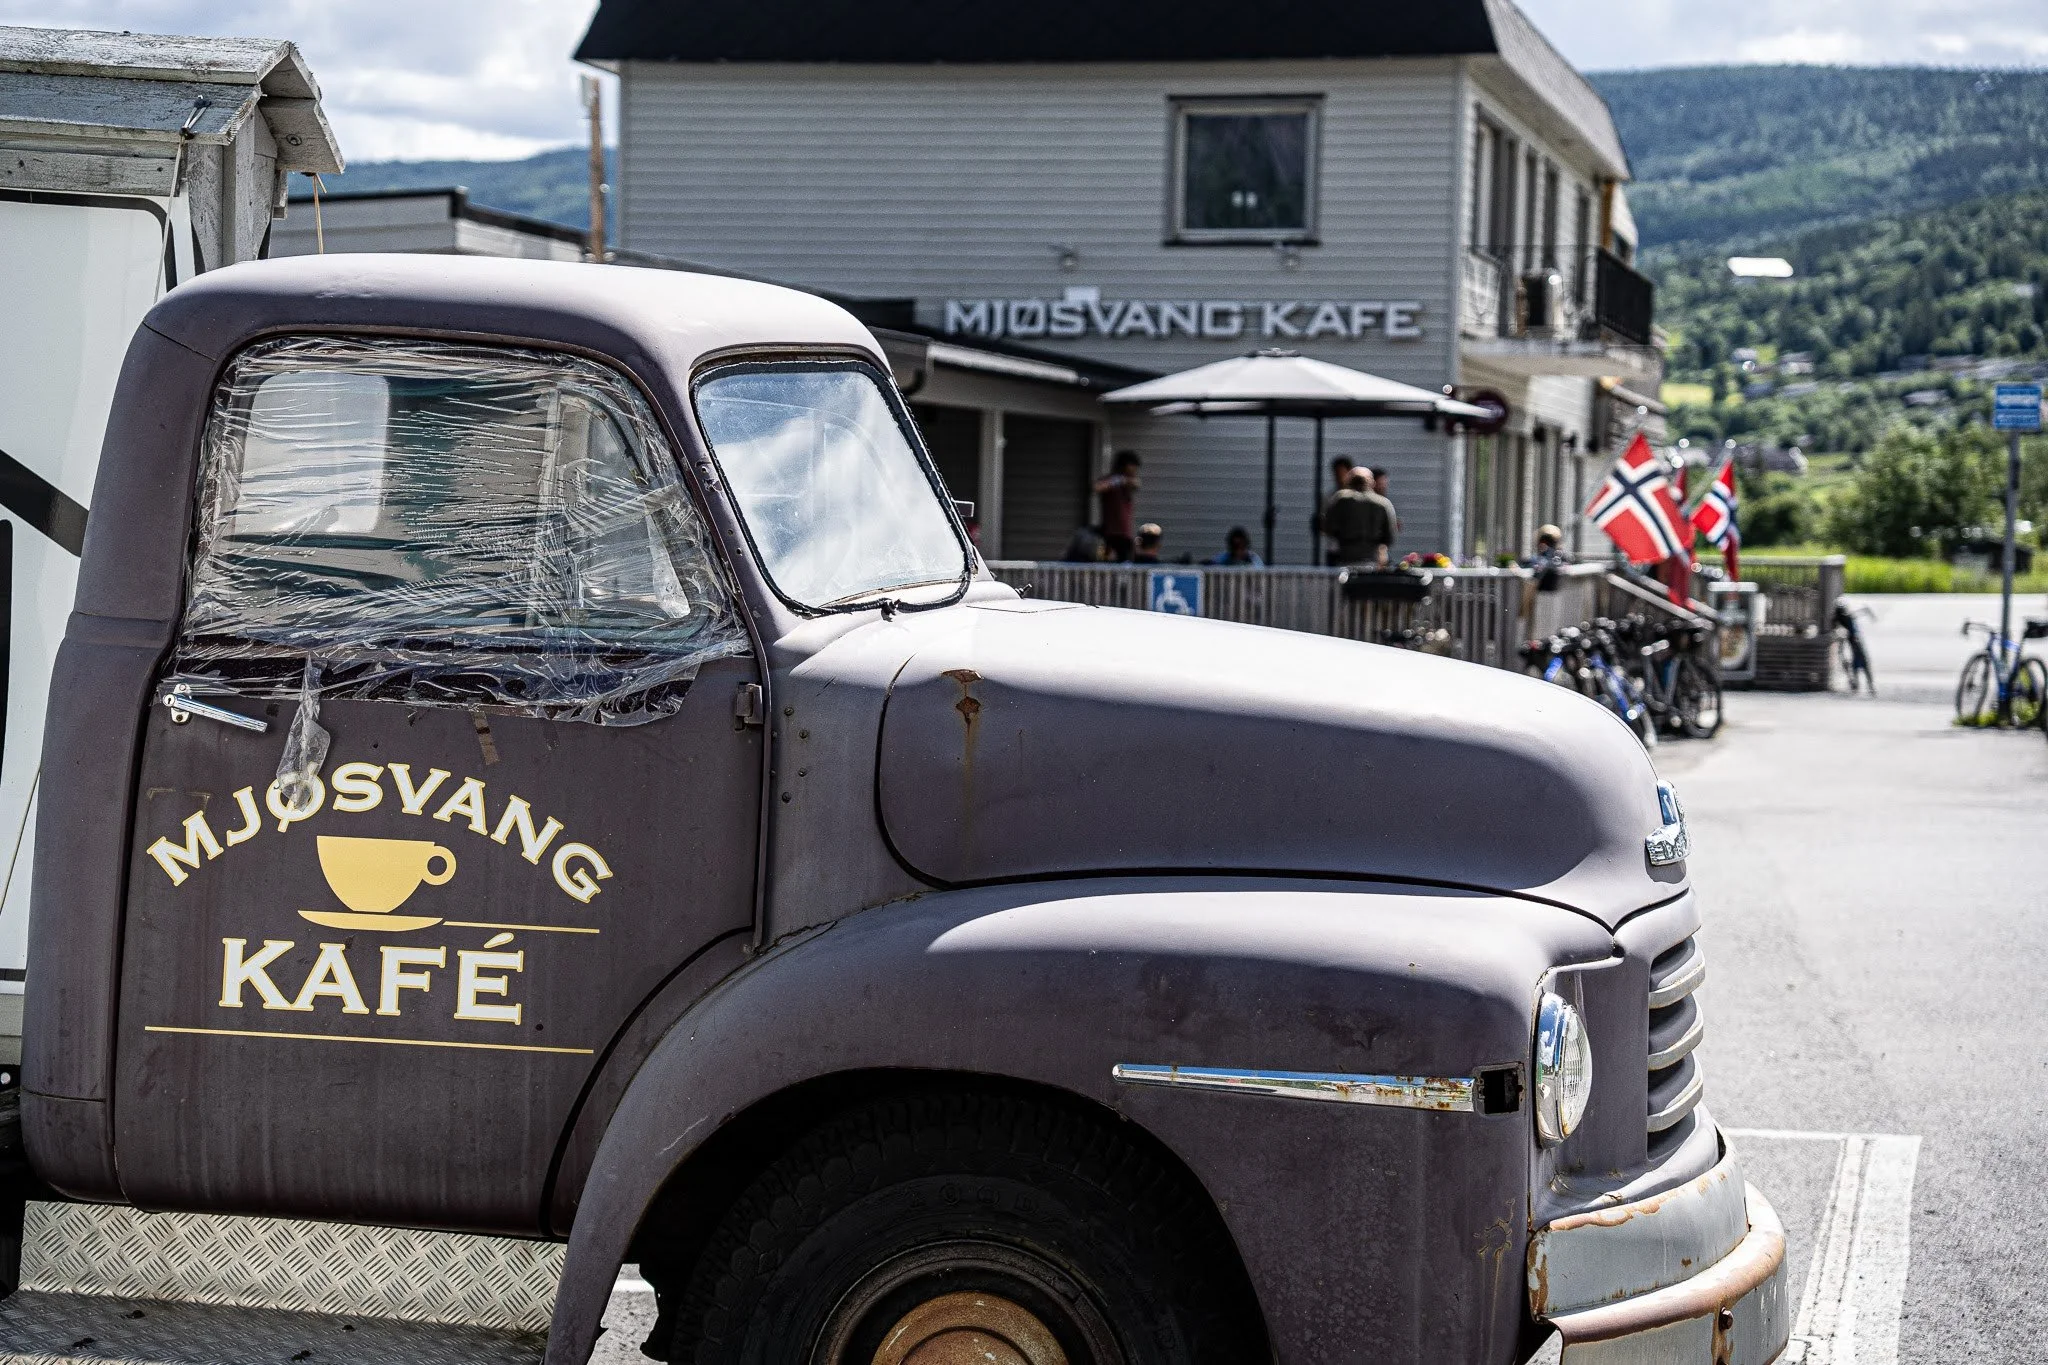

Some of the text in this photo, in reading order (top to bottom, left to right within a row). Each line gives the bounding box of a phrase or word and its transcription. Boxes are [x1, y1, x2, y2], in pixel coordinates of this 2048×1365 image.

[945, 300, 1423, 338] MJØSVANG KAFE
[146, 762, 613, 903] MJØSVANG
[219, 932, 524, 1025] KAFÉ
